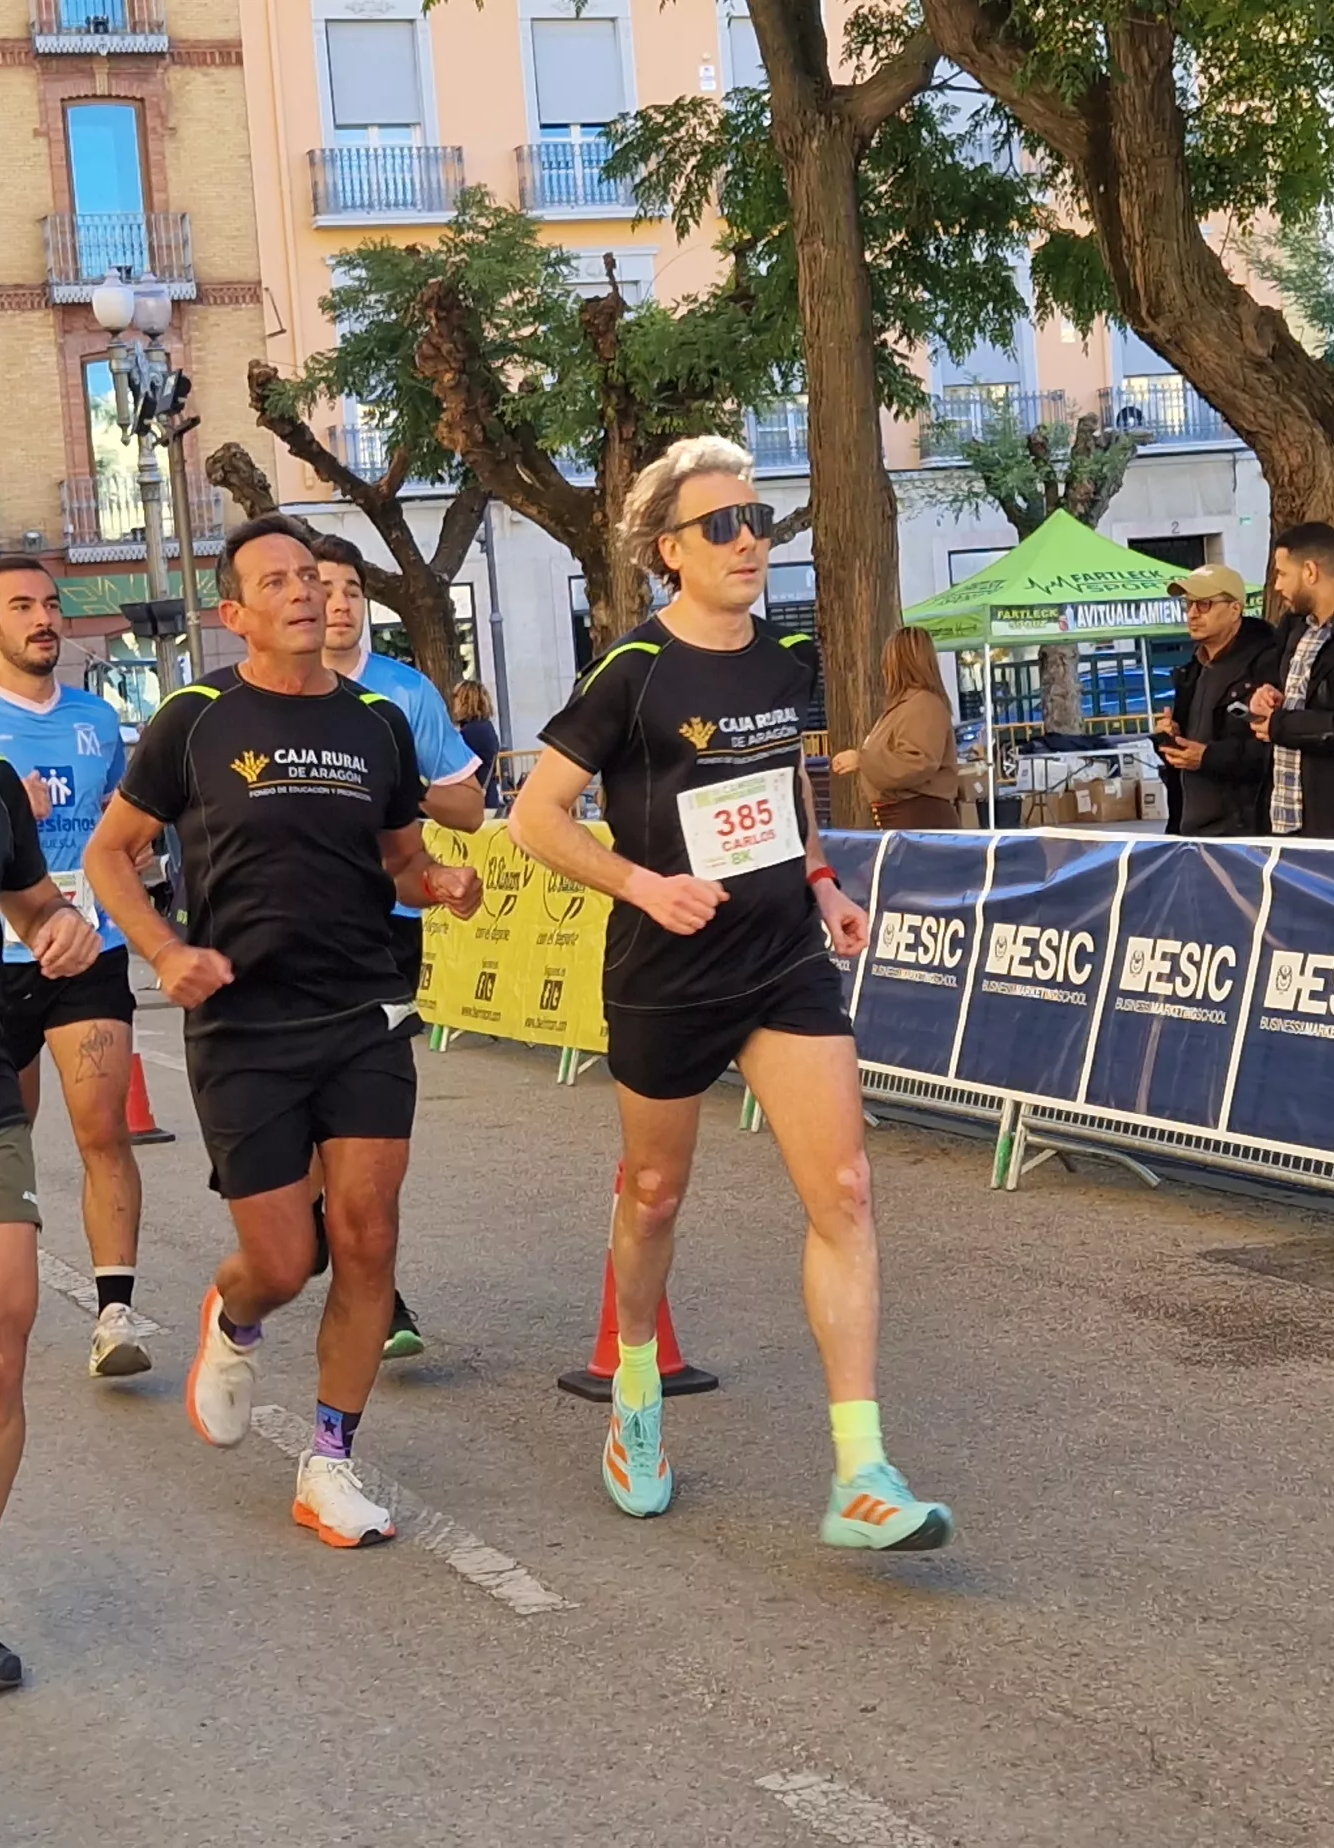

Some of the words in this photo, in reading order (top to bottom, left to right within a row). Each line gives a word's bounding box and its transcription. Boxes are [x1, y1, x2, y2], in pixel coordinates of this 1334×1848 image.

[1171, 520, 1180, 534] 2
[1070, 569, 1164, 584] FARTLECK
[1085, 582, 1169, 594] SPOR
[997, 608, 1059, 620] FARTLECK
[1076, 599, 1185, 629] AVITUALLAMIEN
[718, 715, 756, 733] CAJA
[755, 706, 800, 729] RURAL
[730, 735, 747, 748] DE
[274, 748, 318, 764] CAJA
[321, 750, 368, 773] RURAL
[288, 766, 307, 778] DE
[38, 813, 97, 833] esianos
[713, 798, 773, 837] 385
[721, 829, 777, 852] CARLOS
[730, 849, 754, 865] 8K
[903, 913, 966, 969] ESIC
[1010, 925, 1095, 986] ESIC
[1147, 938, 1237, 1003] ESIC
